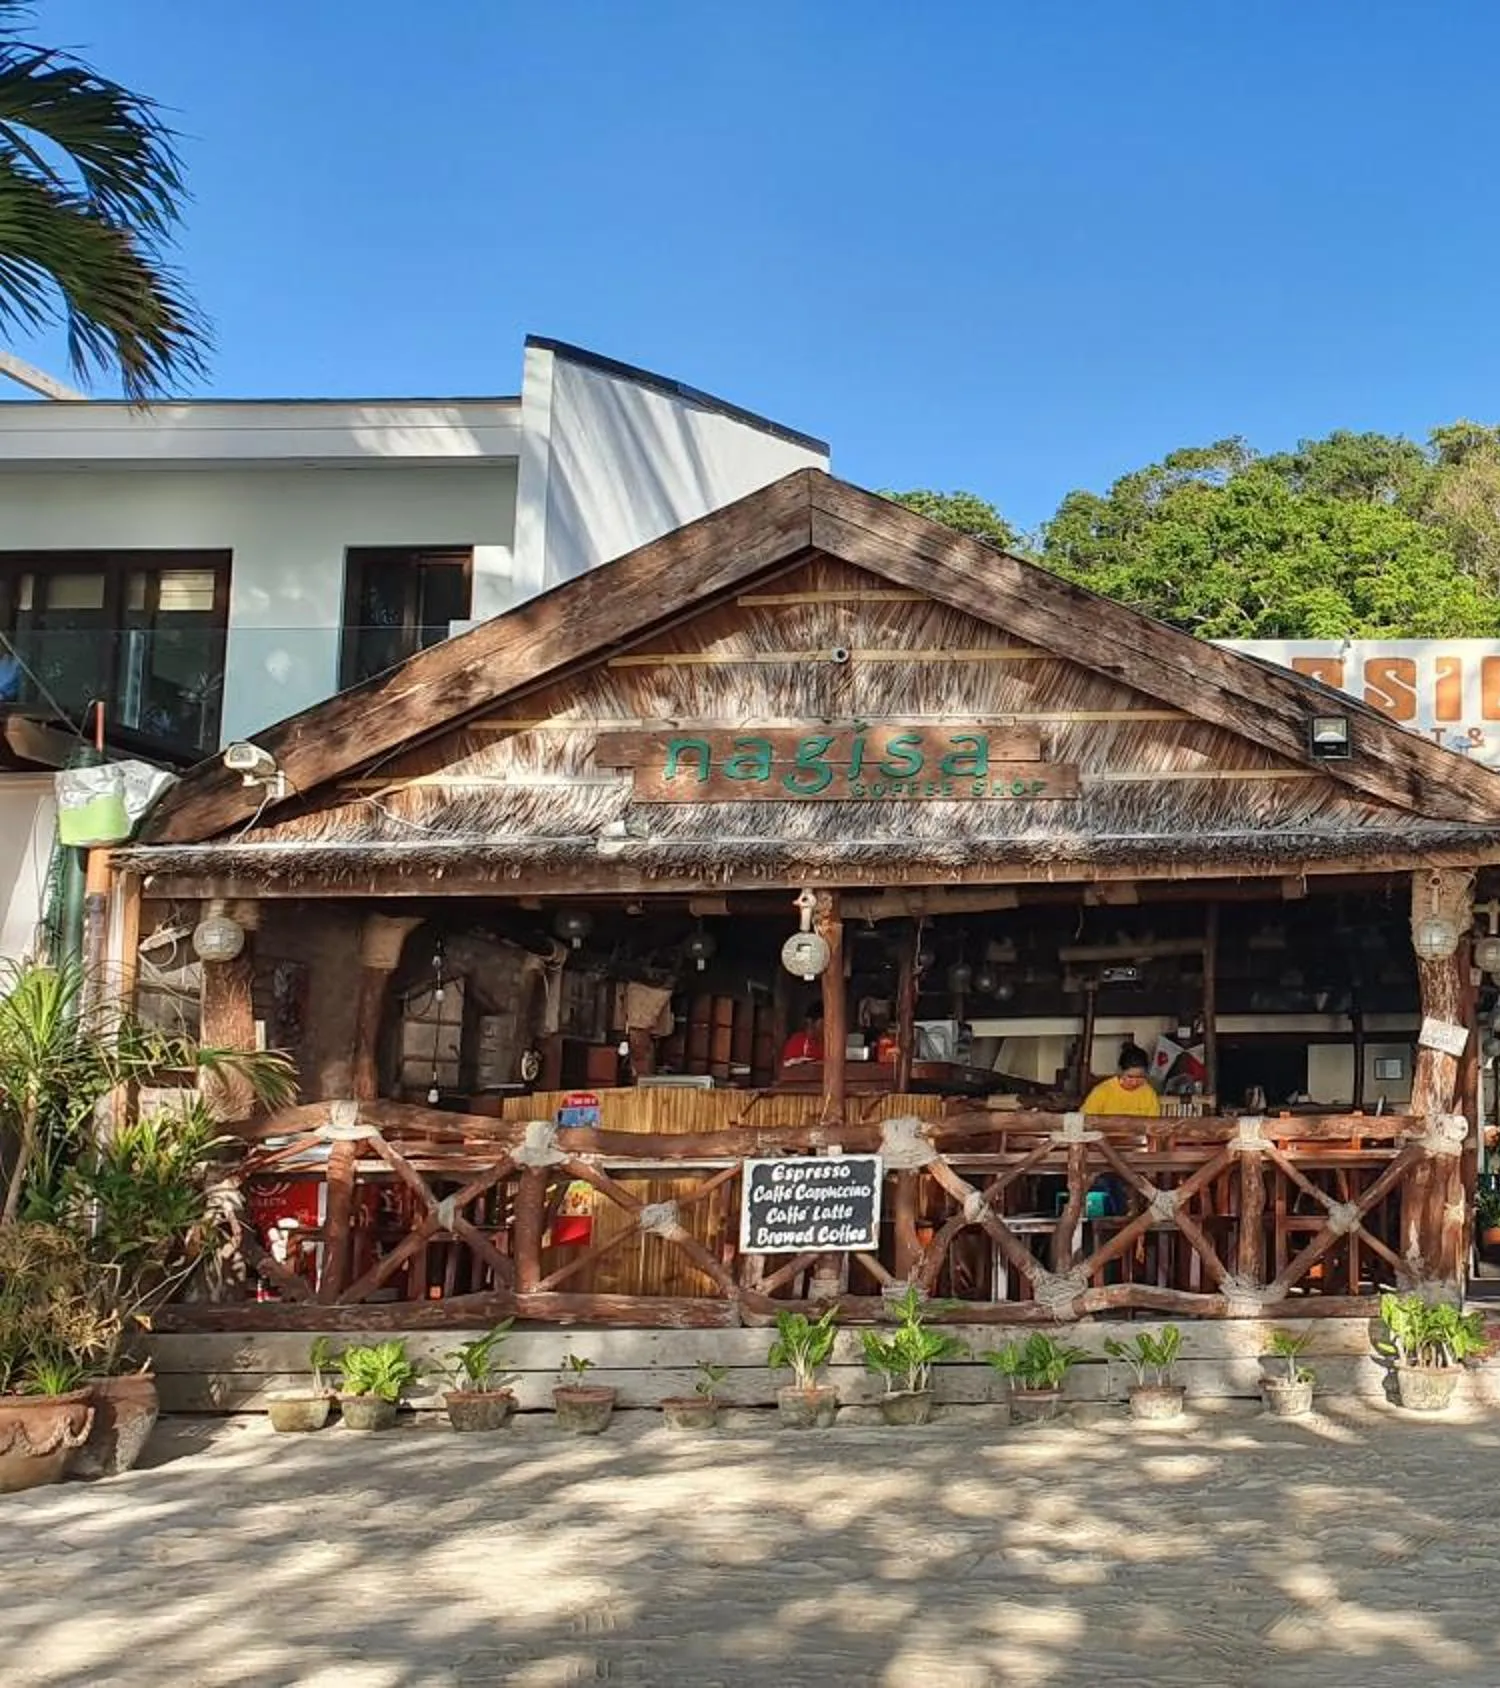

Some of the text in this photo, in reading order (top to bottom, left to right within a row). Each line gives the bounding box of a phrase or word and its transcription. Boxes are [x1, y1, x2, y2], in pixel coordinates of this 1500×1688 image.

[1467, 726, 1485, 748] &
[664, 720, 990, 796] nagisa
[971, 779, 1046, 797] SHOP
[771, 1165, 851, 1183] Espresso
[795, 1180, 871, 1201] Cappuccino
[812, 1203, 853, 1222] Latte
[757, 1223, 867, 1245] Brewed Coffee
